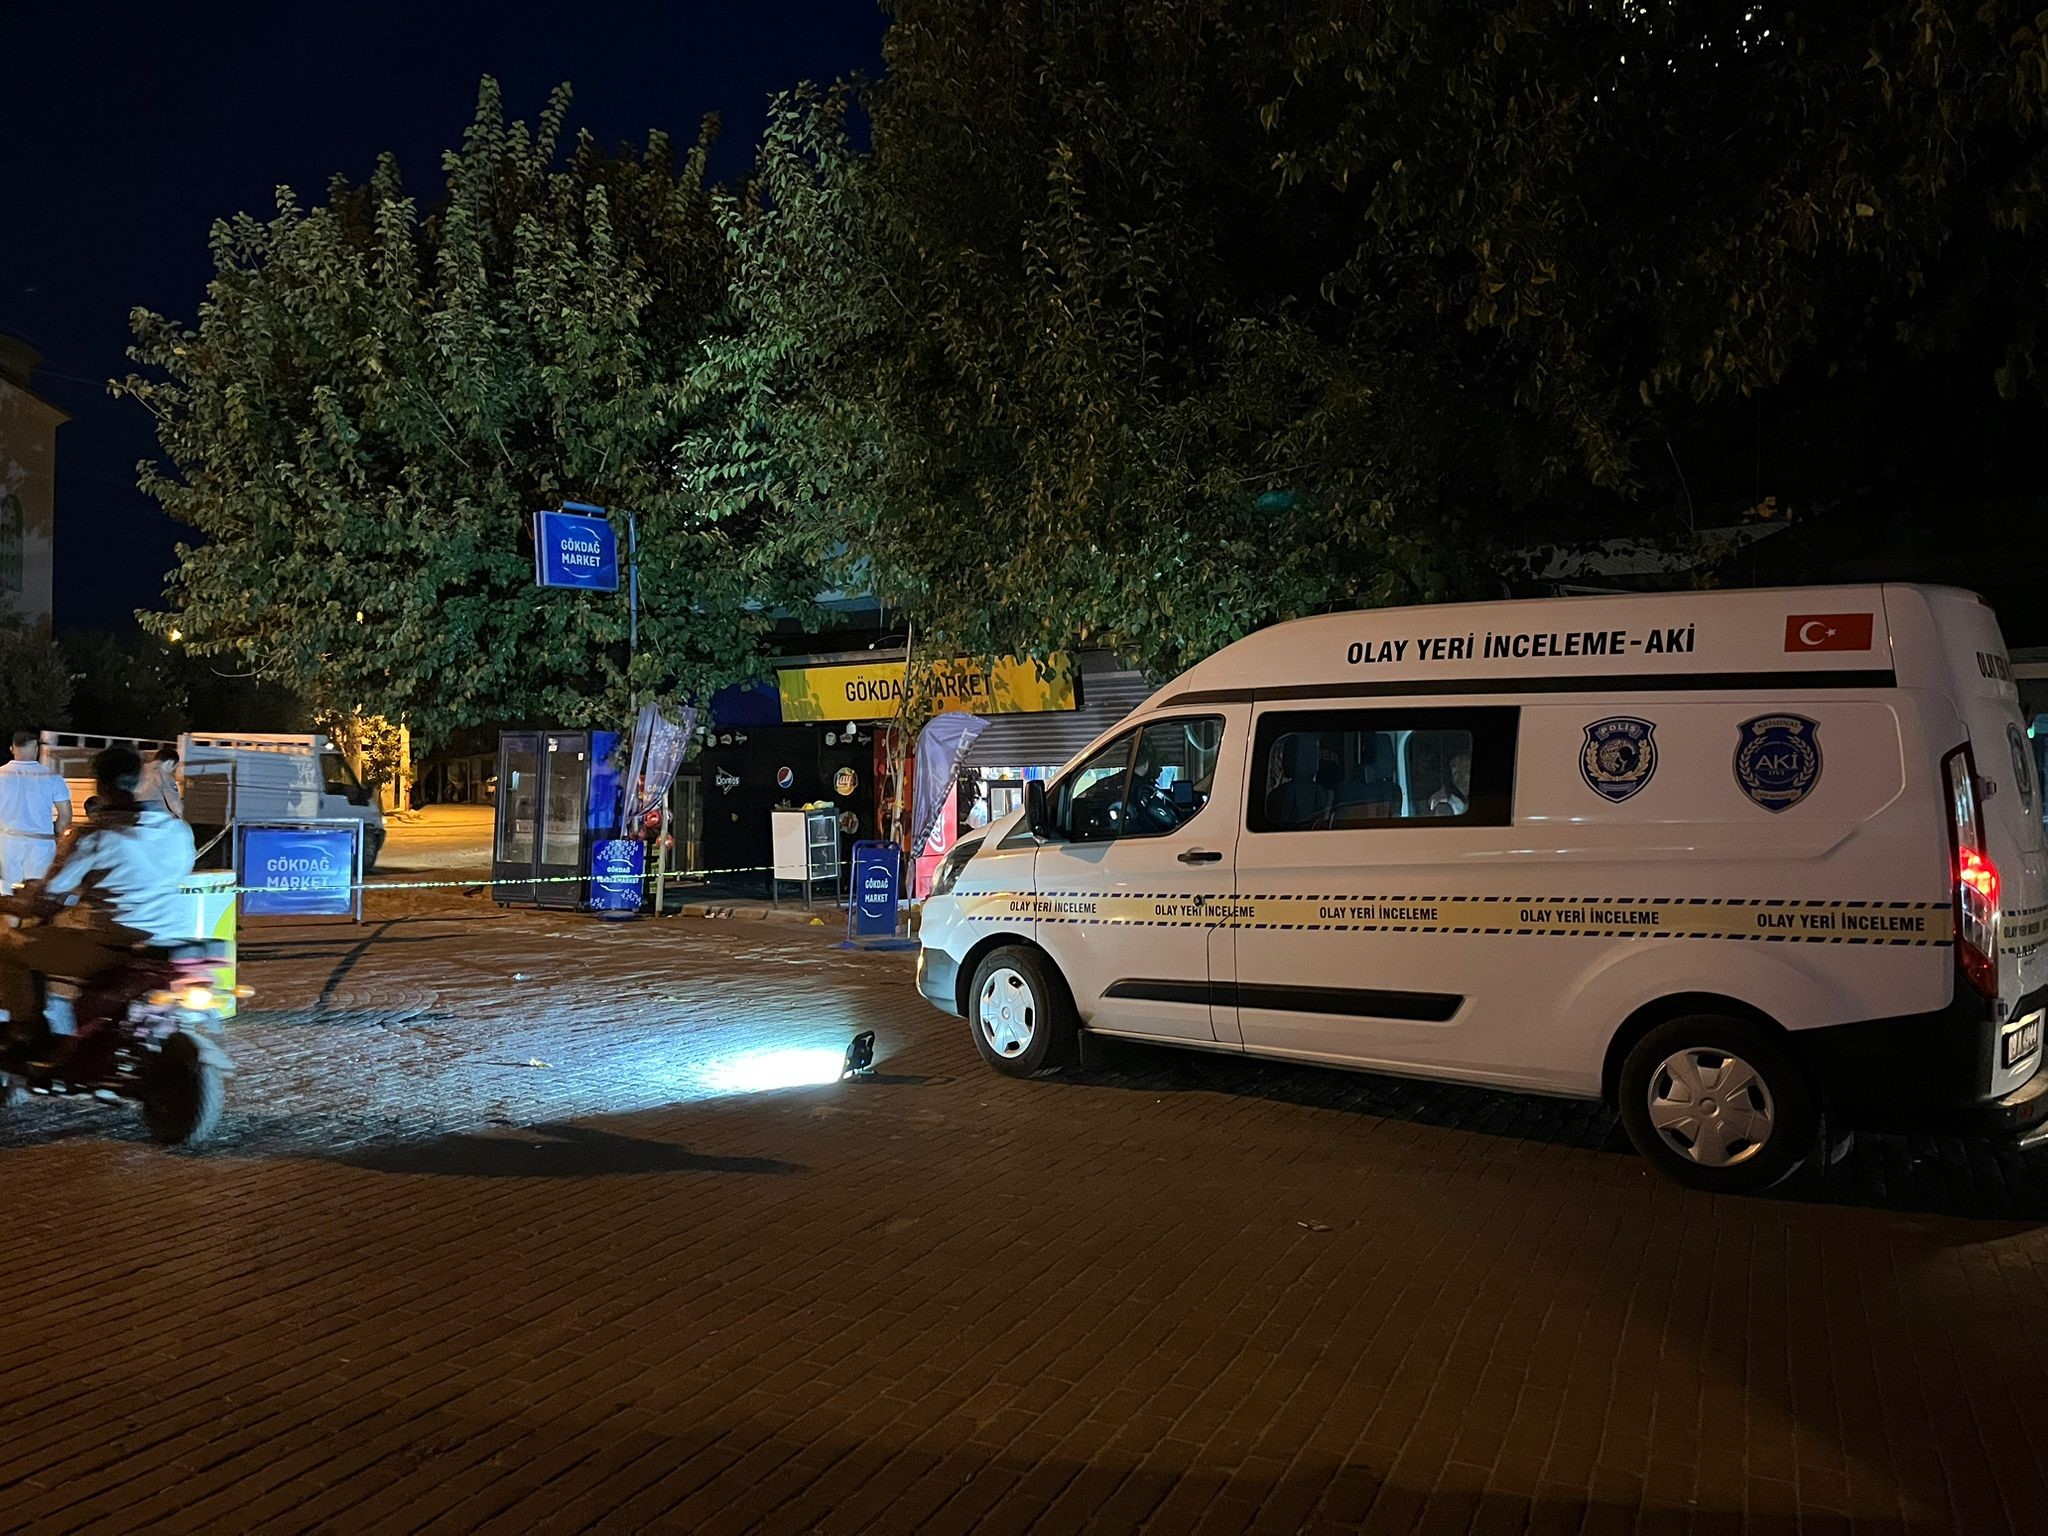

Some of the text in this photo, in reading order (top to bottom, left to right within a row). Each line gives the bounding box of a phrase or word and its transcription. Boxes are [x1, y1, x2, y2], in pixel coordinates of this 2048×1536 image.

[561, 538, 600, 554] GÖKDAĞ
[561, 553, 601, 567] MARKET
[1347, 639, 1410, 665] OLAY
[1417, 633, 1474, 661] YERİ
[1600, 723, 1637, 734] POLİS
[1755, 752, 1799, 770] AKİ
[267, 857, 330, 872] GÖKDAĞ
[267, 876, 330, 888] MARKET
[865, 878, 889, 889] GÖKDAĞ
[865, 893, 889, 903] MARKET
[1009, 899, 1097, 914] OLAY YERİ İNCELEME
[1155, 904, 1178, 916] OLAY
[1205, 904, 1255, 918] İNCELEME
[1319, 905, 1438, 921] OLAY YERİ İNCELEME
[1520, 907, 1660, 925] OLAY YERİ İNCELEME
[1757, 912, 1925, 932] OLAY YERİ İNCELEME
